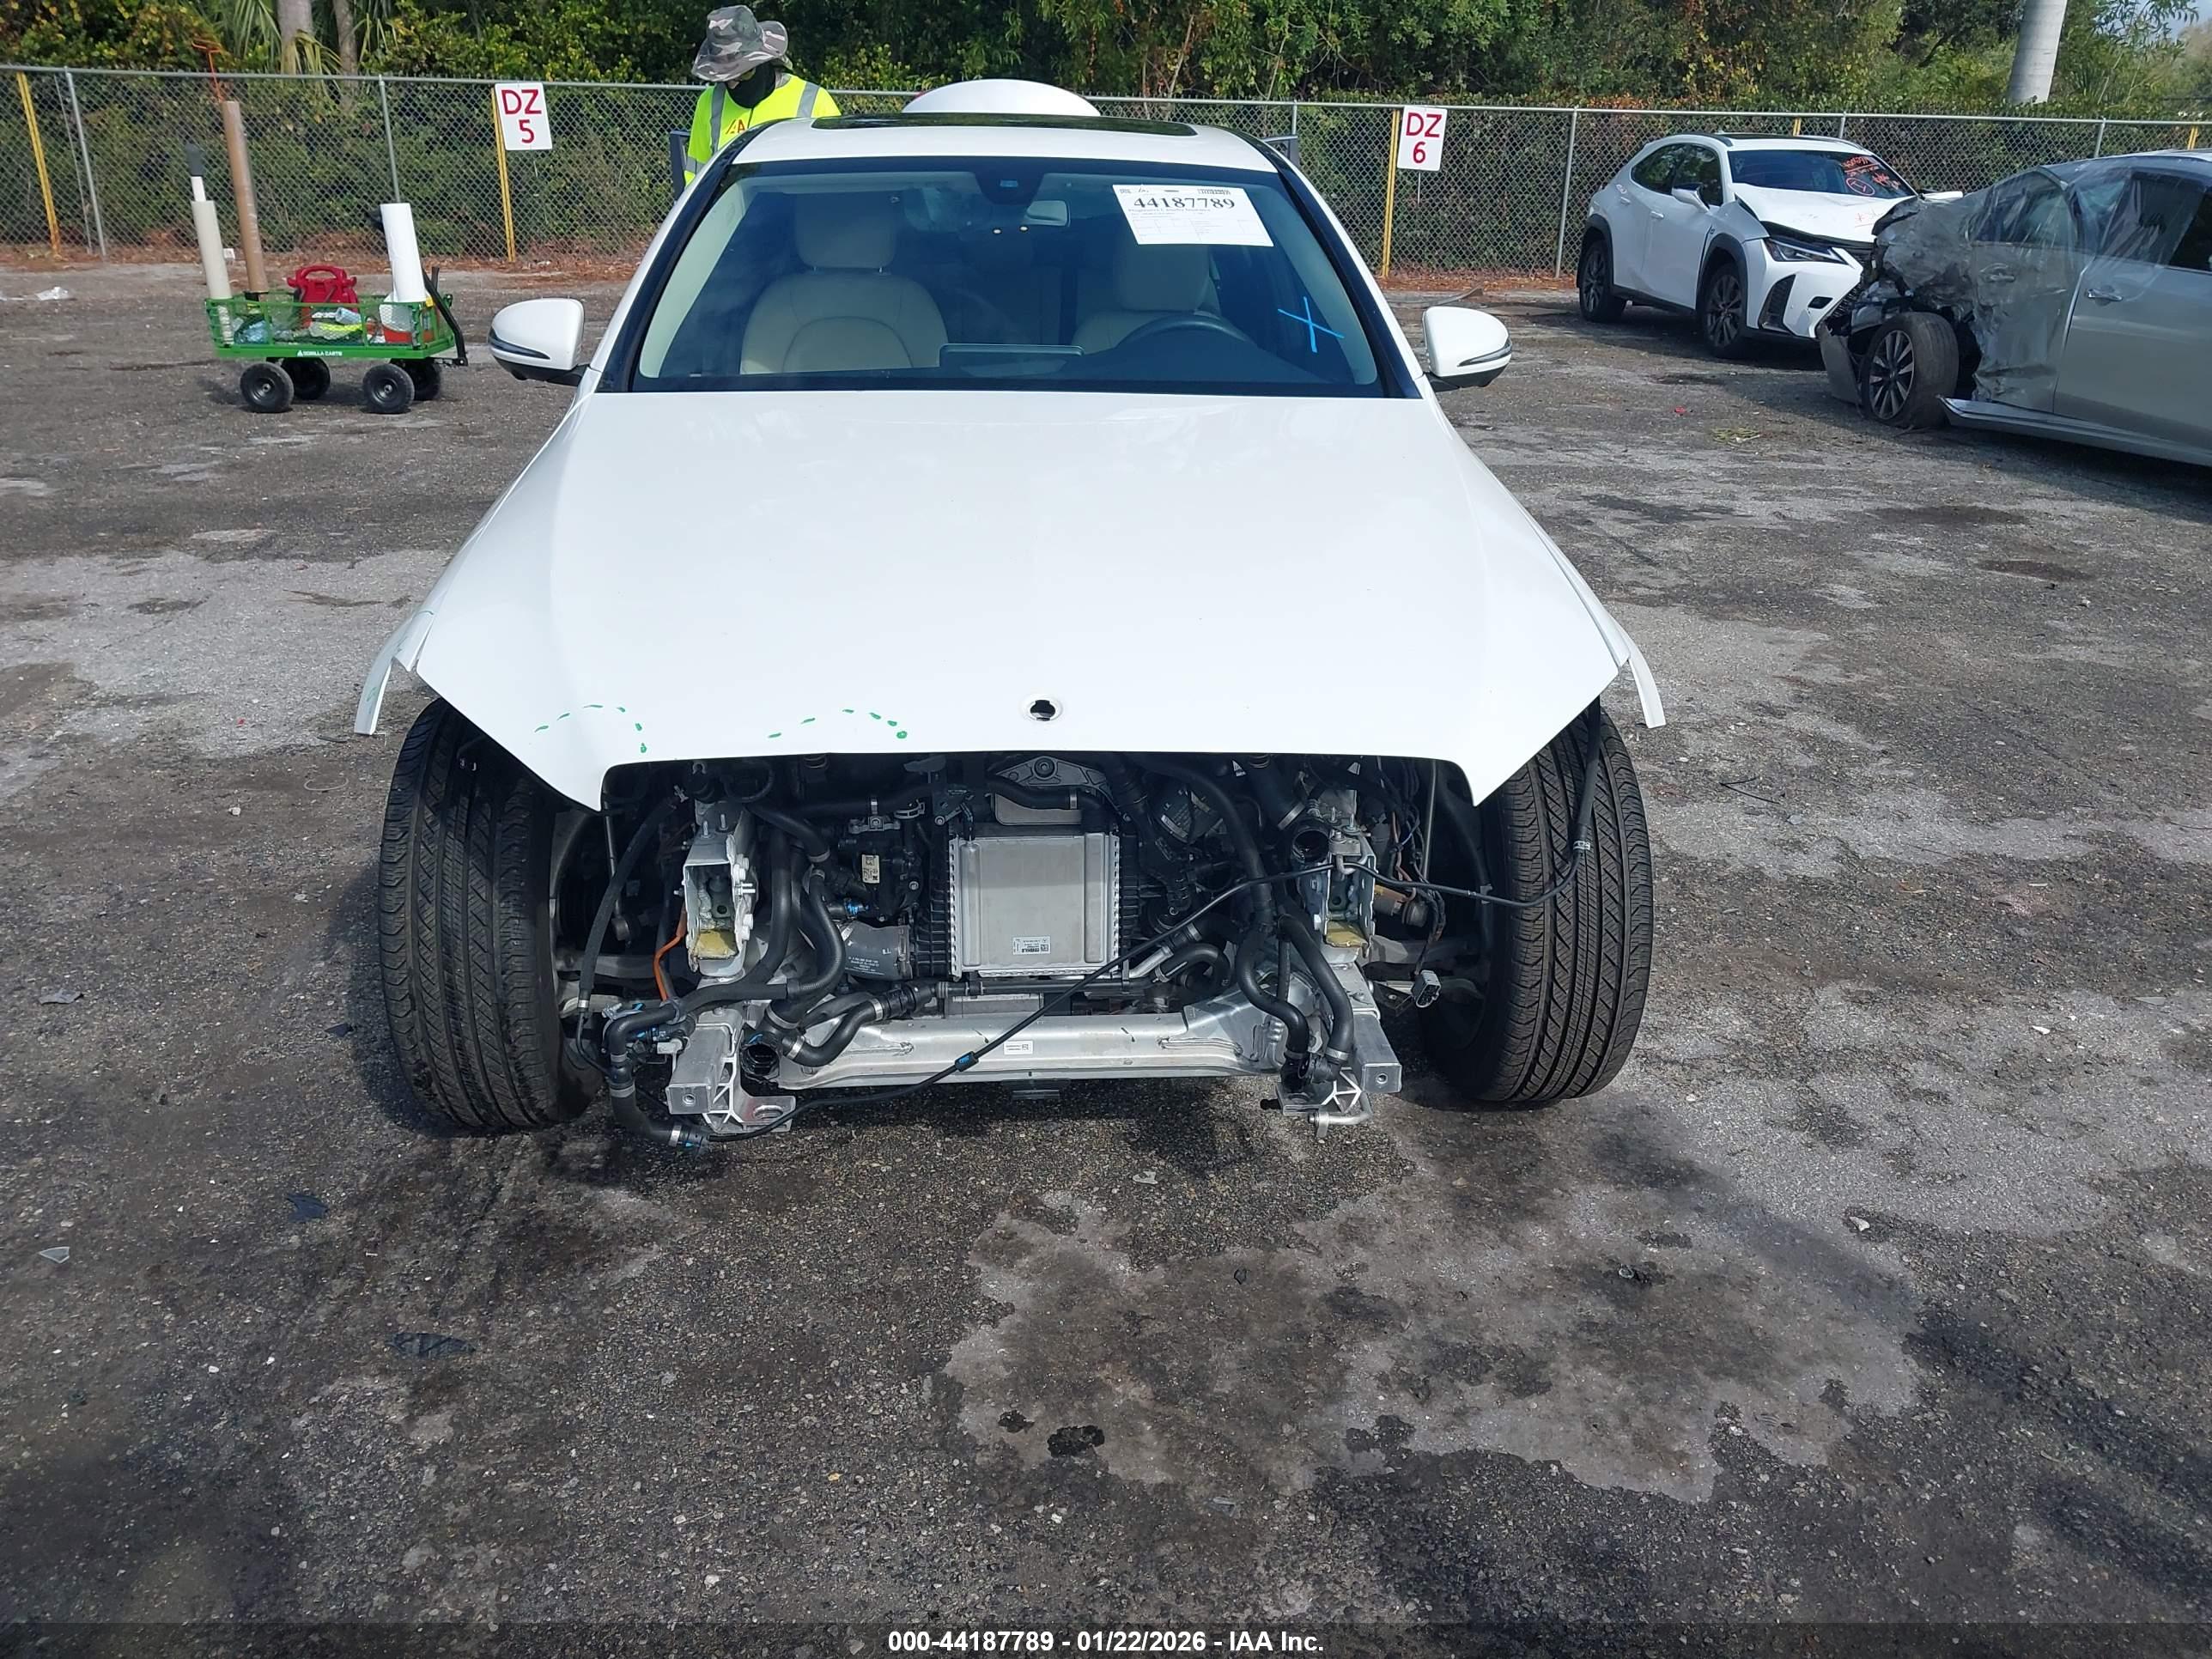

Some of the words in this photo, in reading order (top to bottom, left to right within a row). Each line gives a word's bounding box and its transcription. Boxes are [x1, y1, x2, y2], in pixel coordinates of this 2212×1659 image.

[501, 89, 542, 114] DZ
[519, 119, 534, 143] 5
[1406, 112, 1442, 137] DZ
[1413, 141, 1426, 164] 6
[1133, 197, 1235, 209] 44187789
